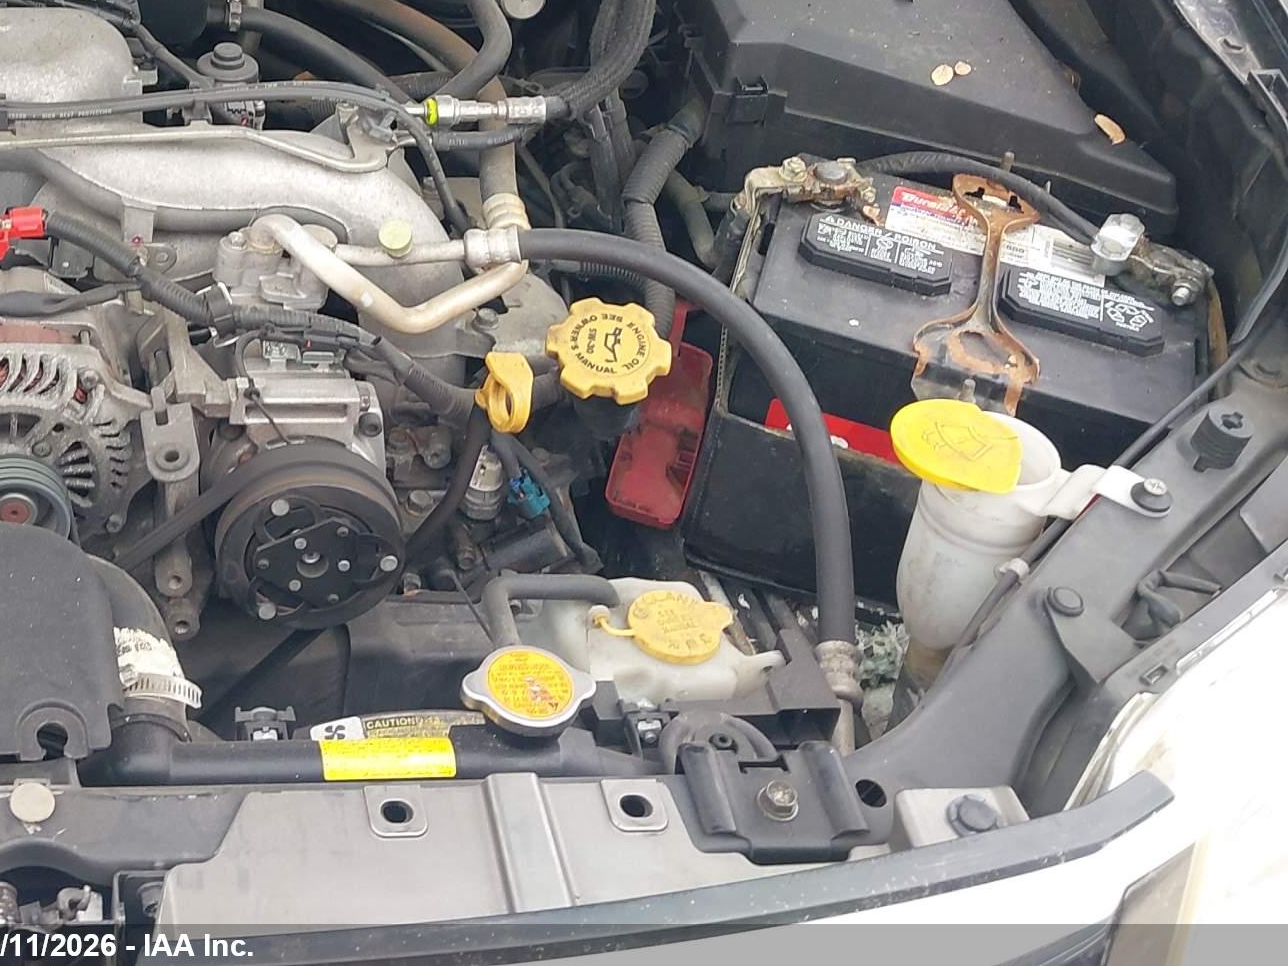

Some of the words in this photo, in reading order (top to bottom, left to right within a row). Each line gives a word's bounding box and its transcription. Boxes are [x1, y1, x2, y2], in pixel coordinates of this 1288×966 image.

[836, 218, 883, 236] DANGER
[893, 233, 937, 250] POISON
[601, 313, 624, 323] SEE
[626, 322, 647, 357] ENGINE
[575, 352, 618, 374] MANUAL
[622, 358, 640, 370] OIL
[366, 715, 417, 730] CAUTION
